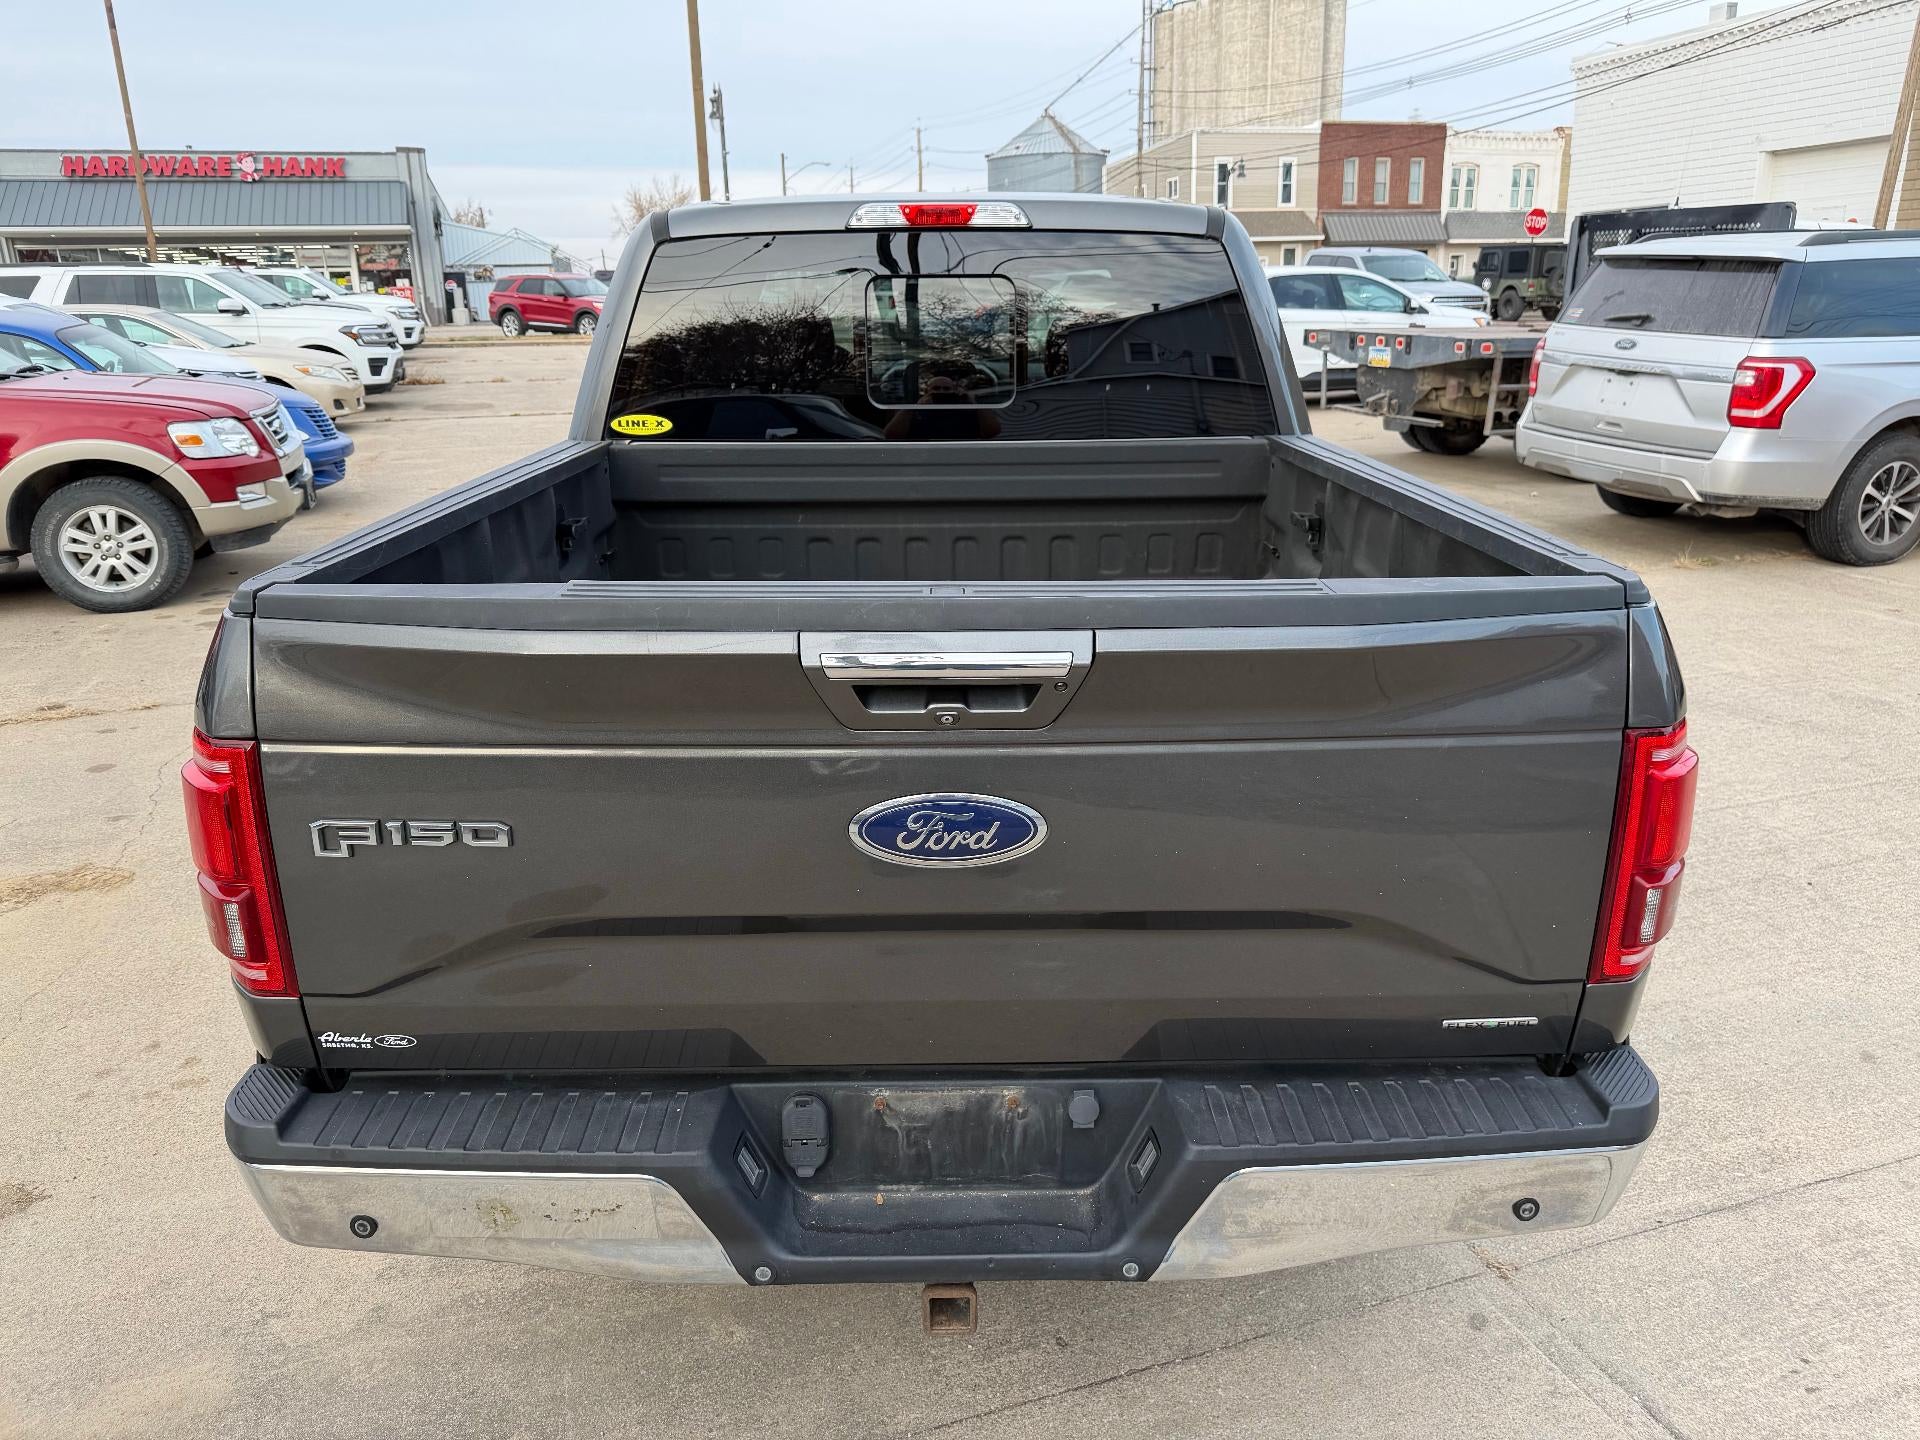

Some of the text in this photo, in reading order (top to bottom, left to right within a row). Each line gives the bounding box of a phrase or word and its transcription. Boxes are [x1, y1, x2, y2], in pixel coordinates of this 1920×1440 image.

[62, 155, 345, 177] HARDWARE HANK
[1525, 215, 1547, 230] STOP
[617, 419, 665, 428] LINE-X
[896, 810, 1001, 851] Ford
[1447, 1019, 1536, 1030] FLEX FUEL
[317, 1031, 373, 1043] Aberle
[383, 1036, 409, 1046] Ford
